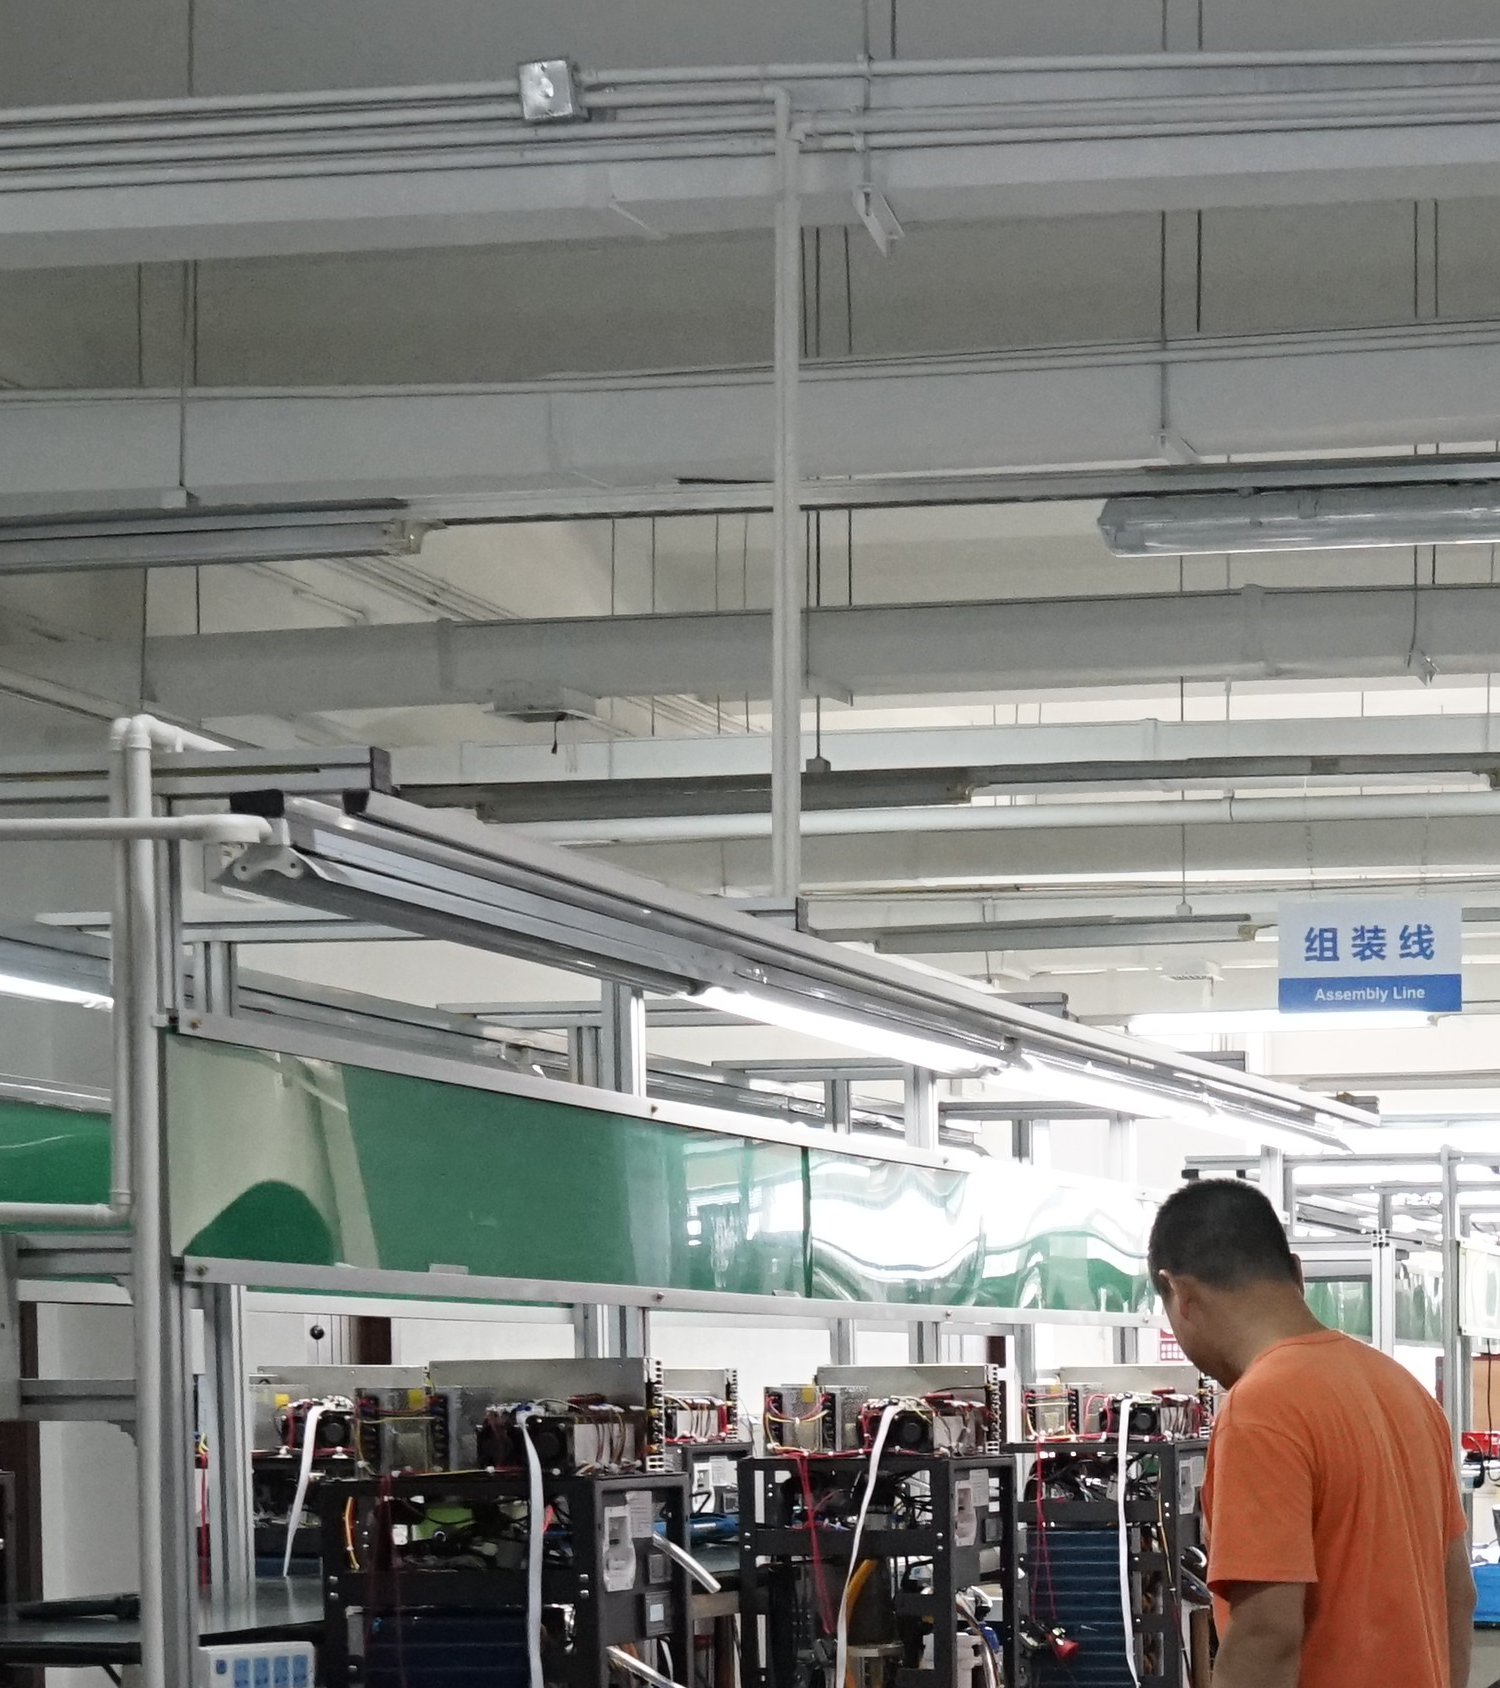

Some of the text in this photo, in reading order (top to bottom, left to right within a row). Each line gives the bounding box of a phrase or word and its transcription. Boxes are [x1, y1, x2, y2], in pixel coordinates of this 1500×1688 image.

[1304, 924, 1435, 962] 组装线
[1314, 986, 1425, 1002] Assembly Line
